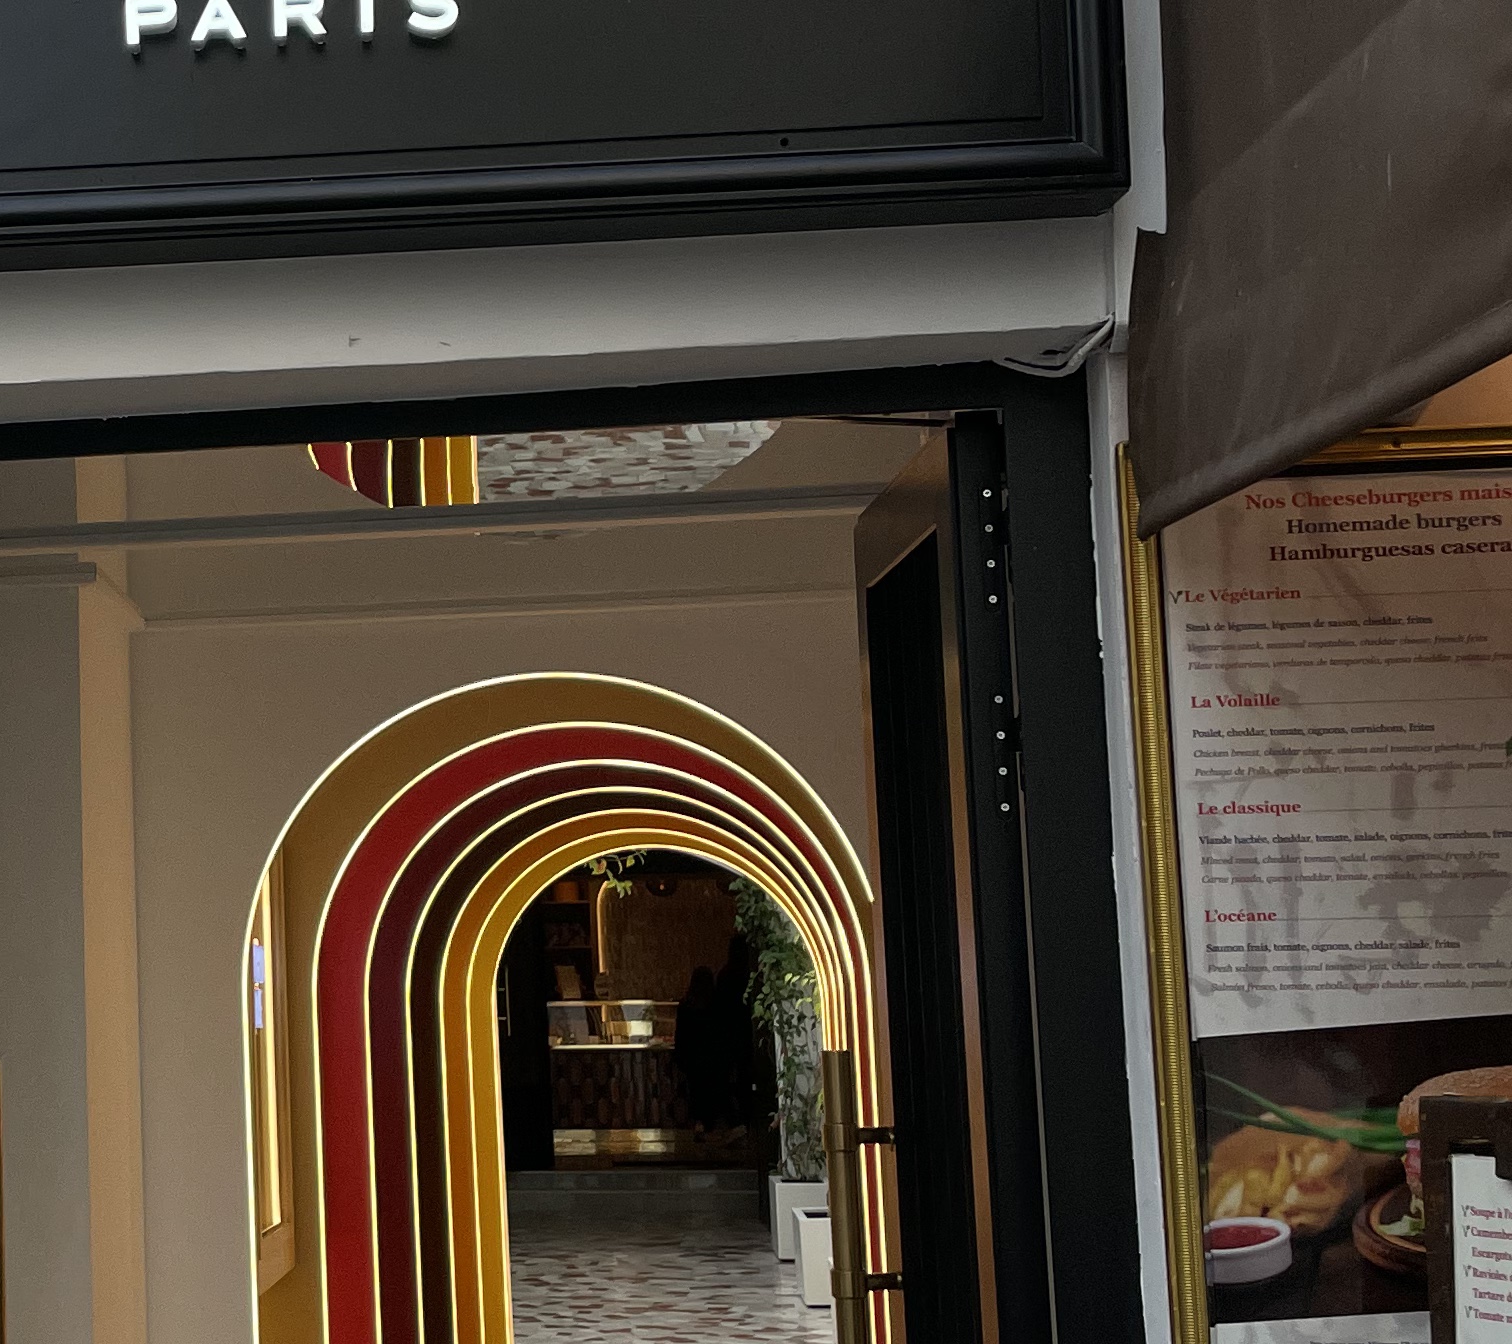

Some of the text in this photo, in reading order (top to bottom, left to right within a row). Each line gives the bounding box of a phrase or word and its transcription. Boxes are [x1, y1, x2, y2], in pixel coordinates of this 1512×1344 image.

[1245, 494, 1285, 510] Nos
[1292, 488, 1452, 510] Cheeseburgers
[1287, 511, 1502, 534] Homemade burgers
[1270, 543, 1435, 562] Hamburguesas
[1185, 588, 1300, 604] Le Végétarien
[1191, 693, 1280, 708] La Volaille
[1198, 800, 1301, 816] Le classique
[1205, 909, 1277, 923] L'océane
